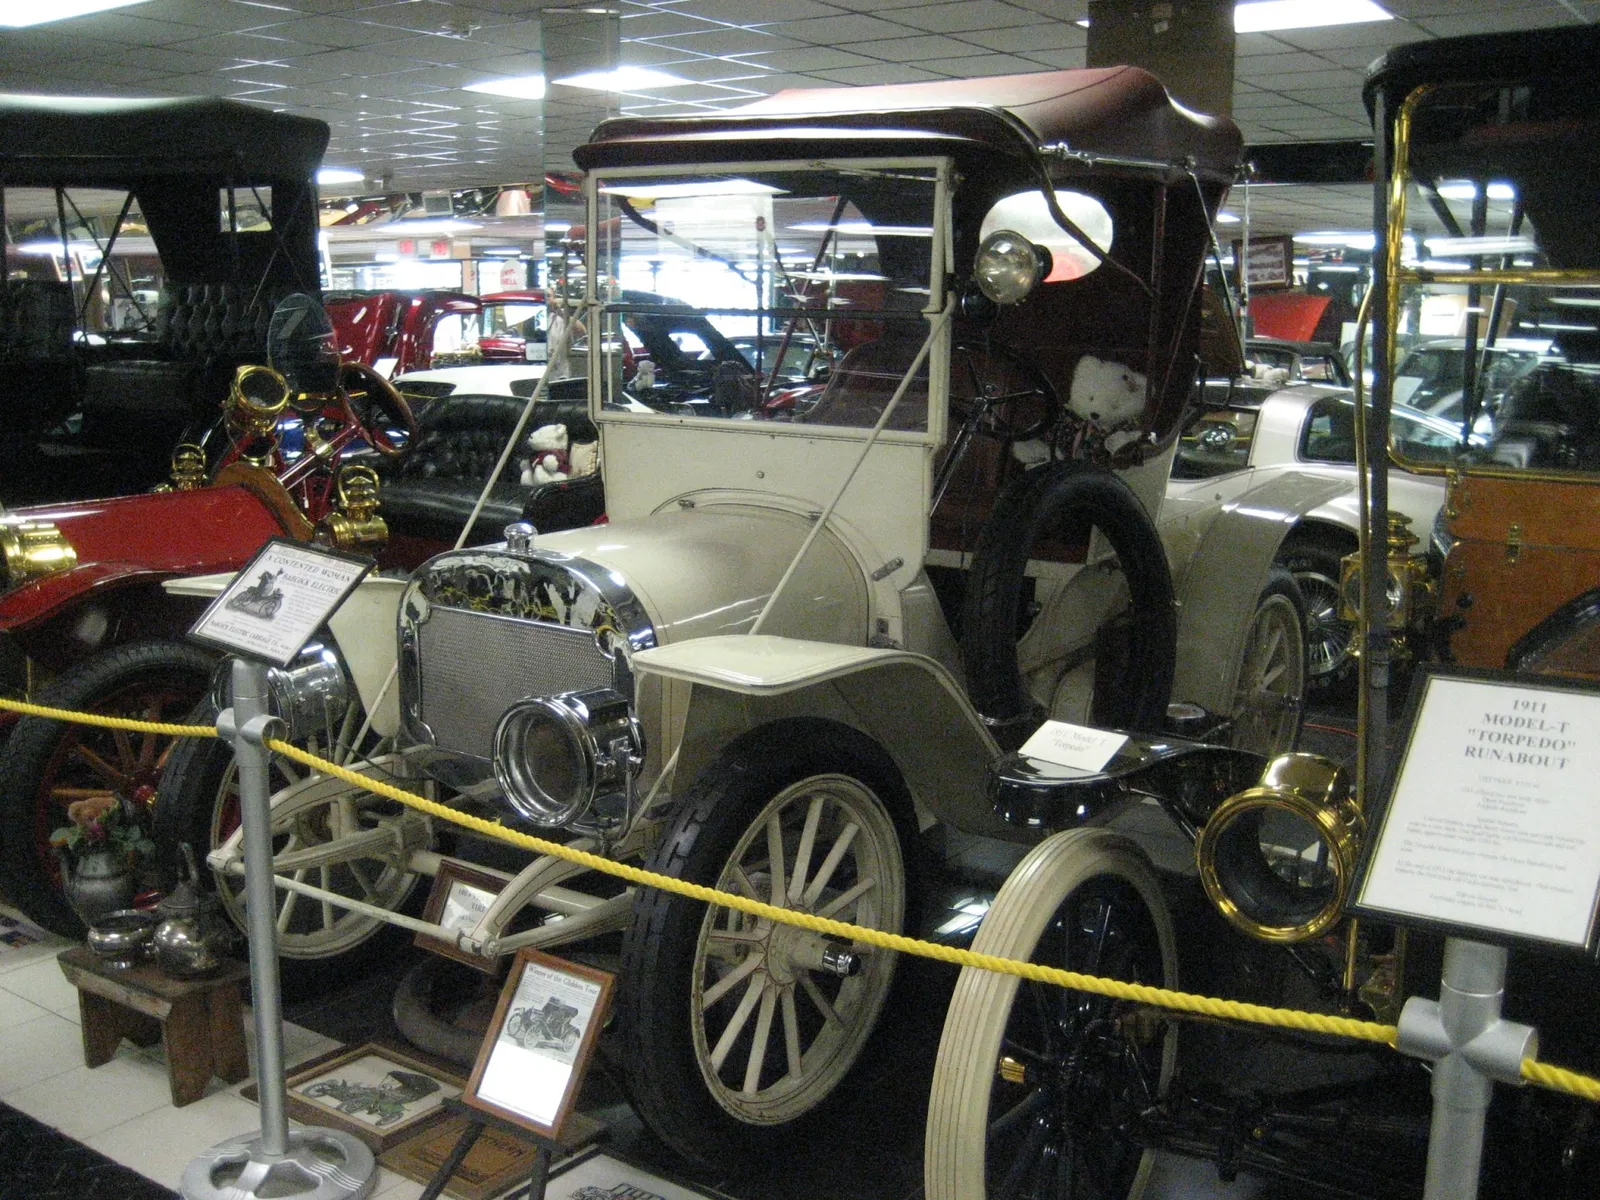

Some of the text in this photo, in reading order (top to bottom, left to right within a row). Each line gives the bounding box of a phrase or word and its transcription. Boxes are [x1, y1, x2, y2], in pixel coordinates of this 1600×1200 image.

[273, 556, 320, 574] CONTENTED
[321, 568, 351, 582] WOMAN
[310, 580, 342, 594] ELECTRIC
[1512, 699, 1548, 714] 1911
[1481, 712, 1571, 734] MODEL-T
[1467, 728, 1577, 752] "TORPEDO"
[1464, 745, 1571, 770] RUNABOUT
